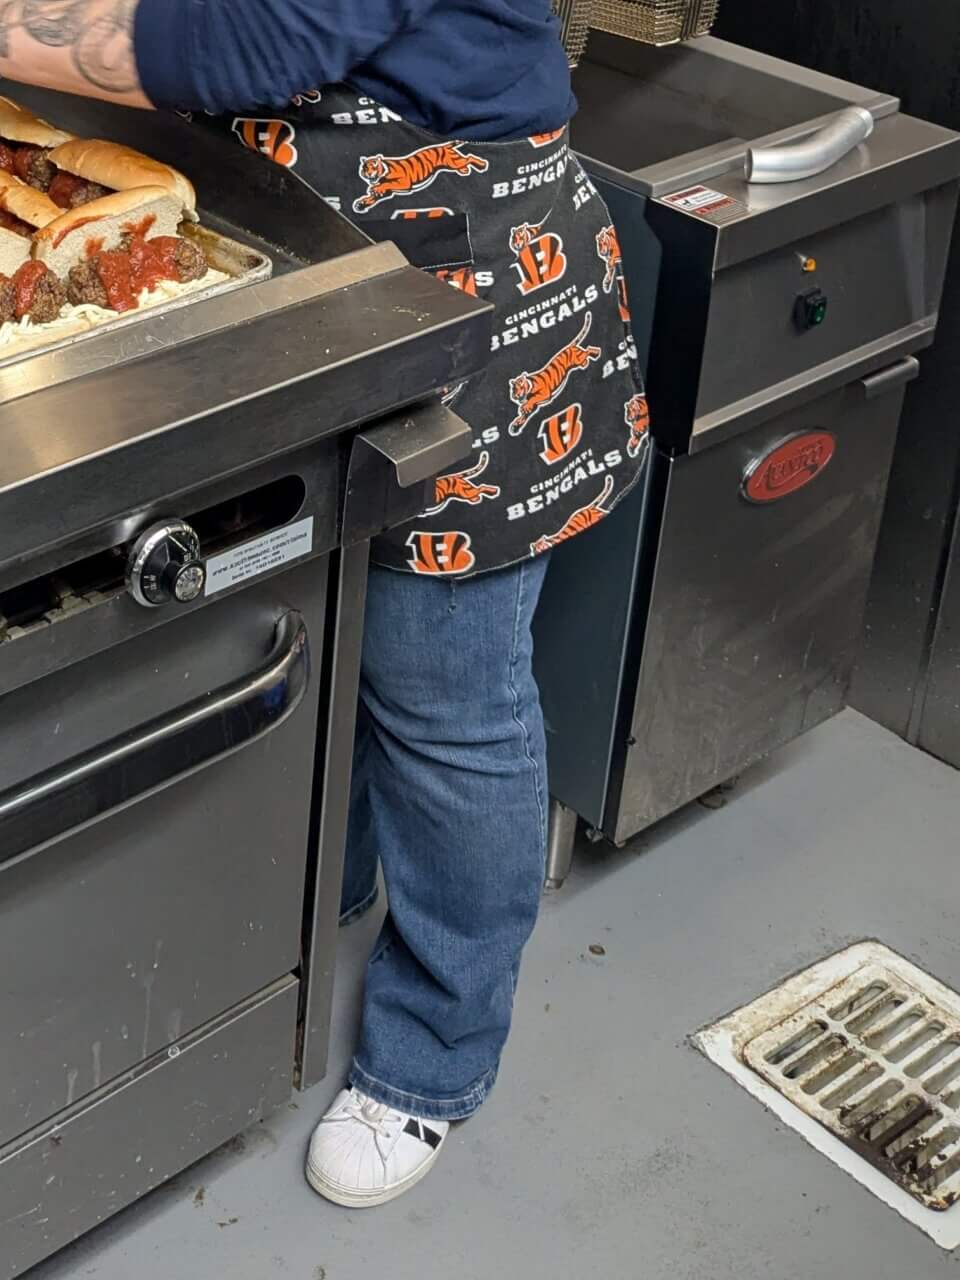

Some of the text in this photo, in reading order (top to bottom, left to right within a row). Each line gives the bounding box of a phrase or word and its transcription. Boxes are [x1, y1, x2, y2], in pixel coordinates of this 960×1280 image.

[504, 284, 578, 326] CINCINNATI
[506, 449, 622, 521] BENGALS
[529, 447, 593, 494] CINCINNATI
